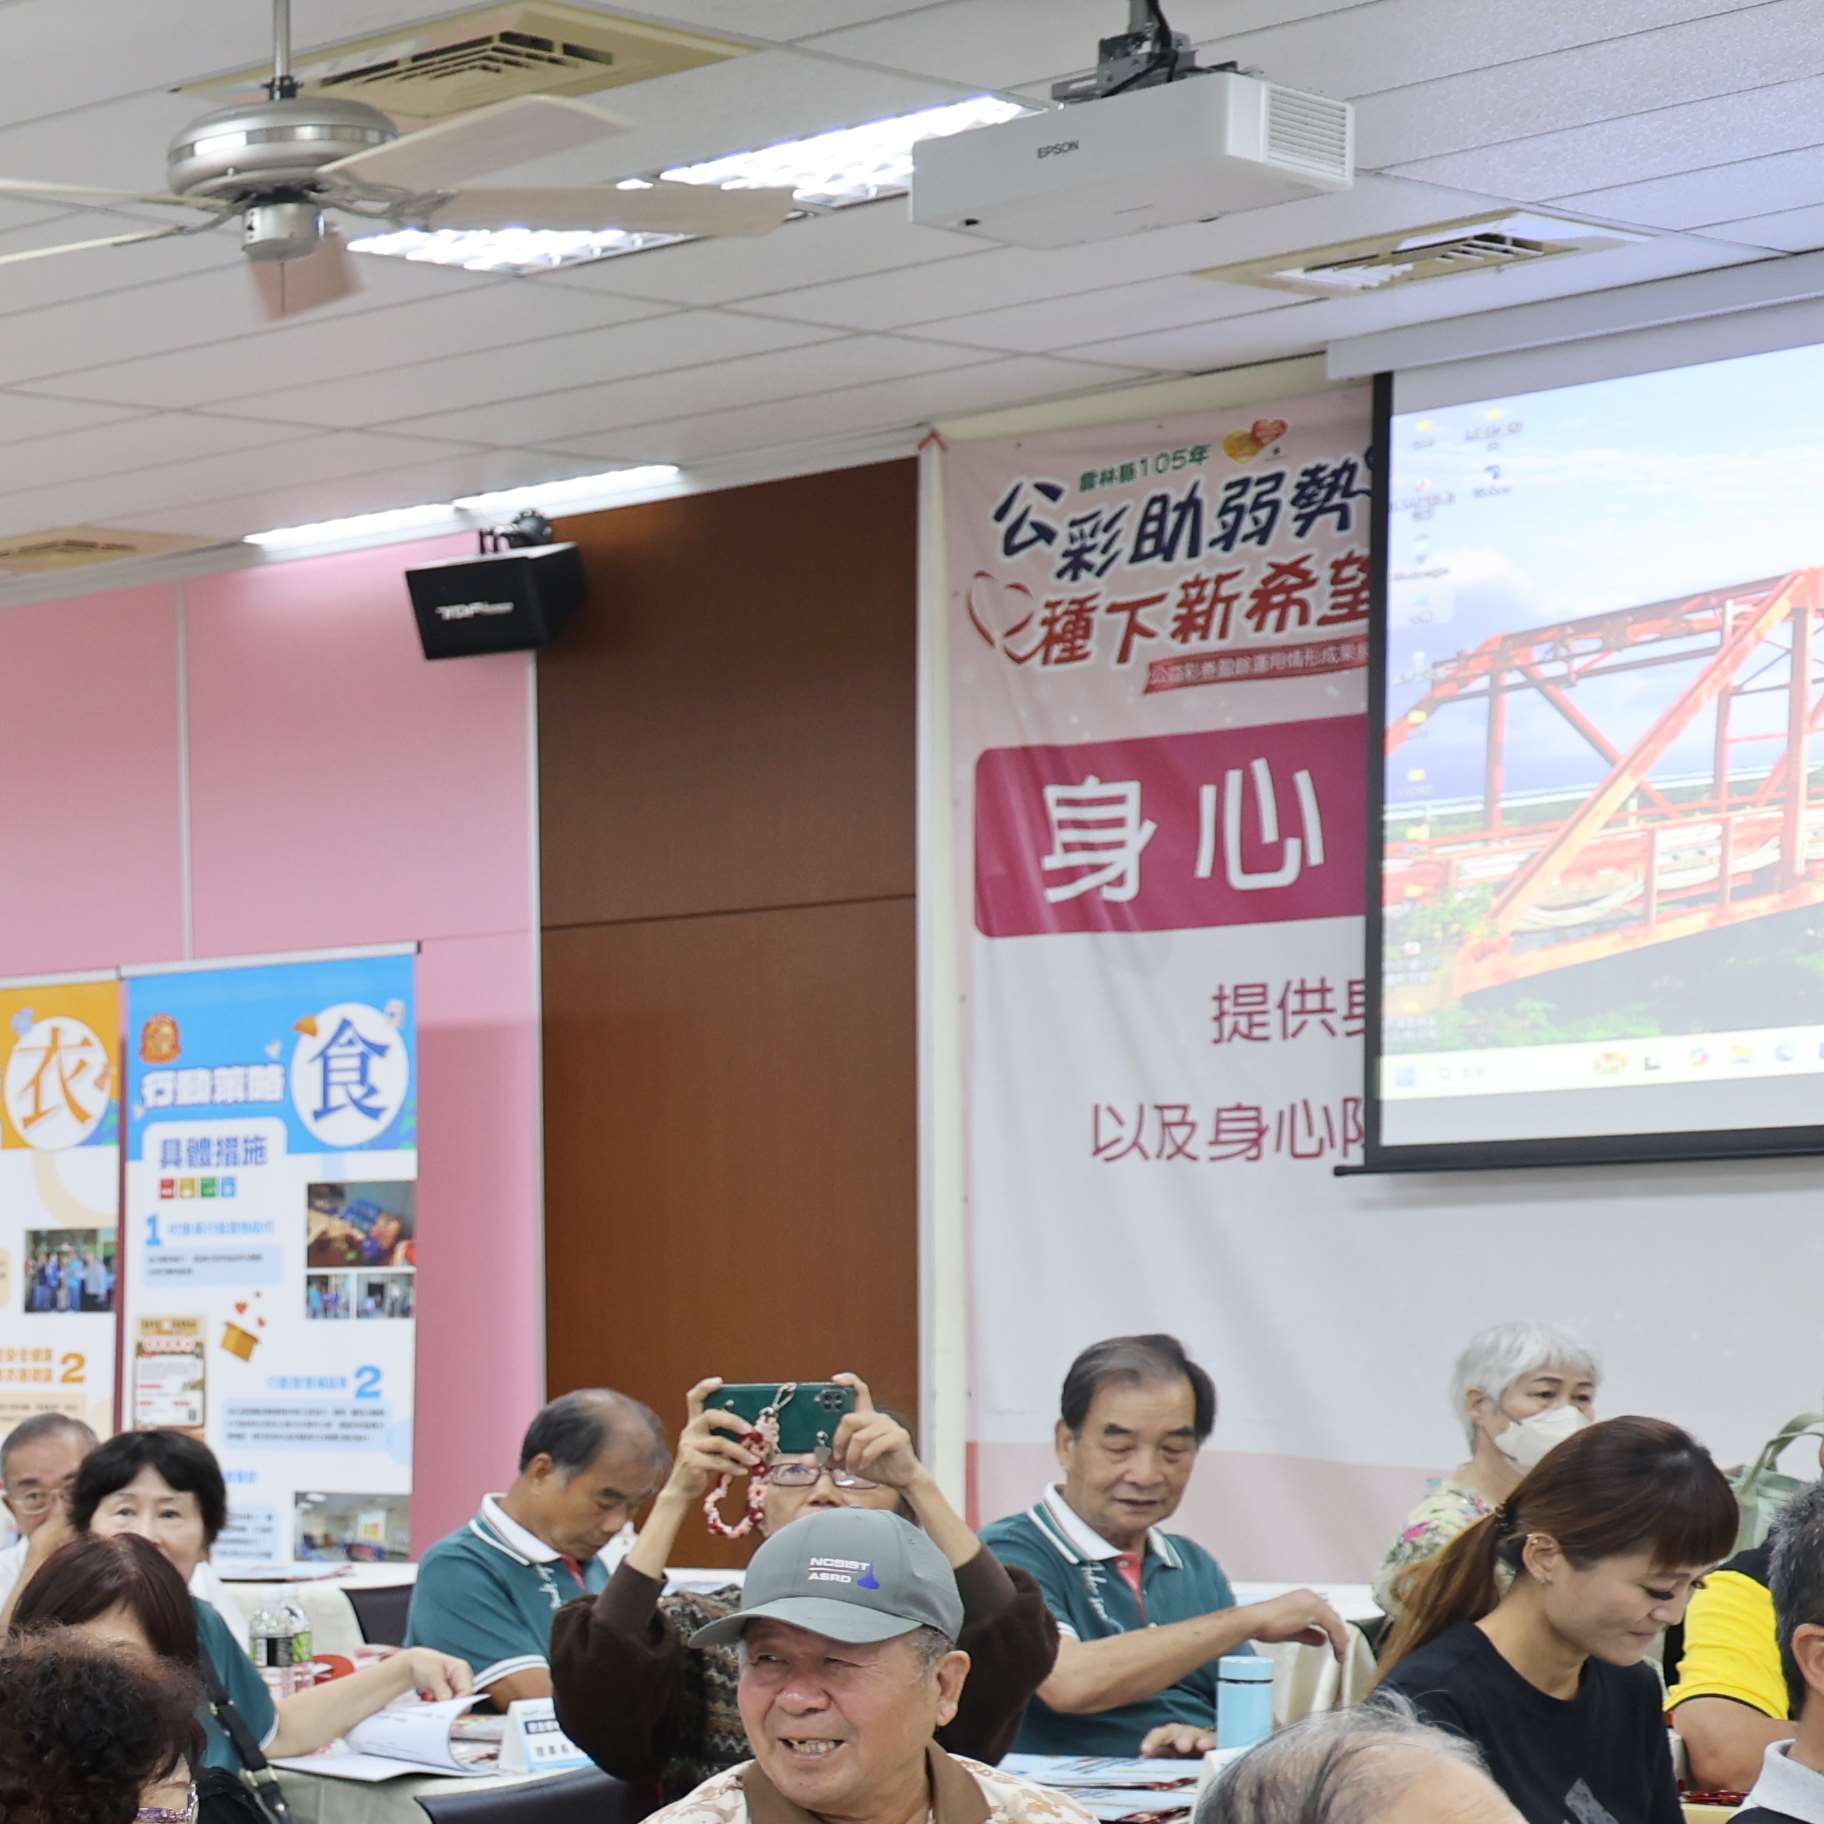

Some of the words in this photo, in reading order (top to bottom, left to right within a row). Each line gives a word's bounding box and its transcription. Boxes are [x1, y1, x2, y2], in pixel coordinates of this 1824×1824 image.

[1037, 140, 1080, 159] EPSON
[22, 1026, 93, 1132] 衣
[309, 1018, 390, 1124] 食
[146, 1215, 161, 1246] 1
[61, 1352, 86, 1384] 2
[355, 1364, 382, 1400] 2
